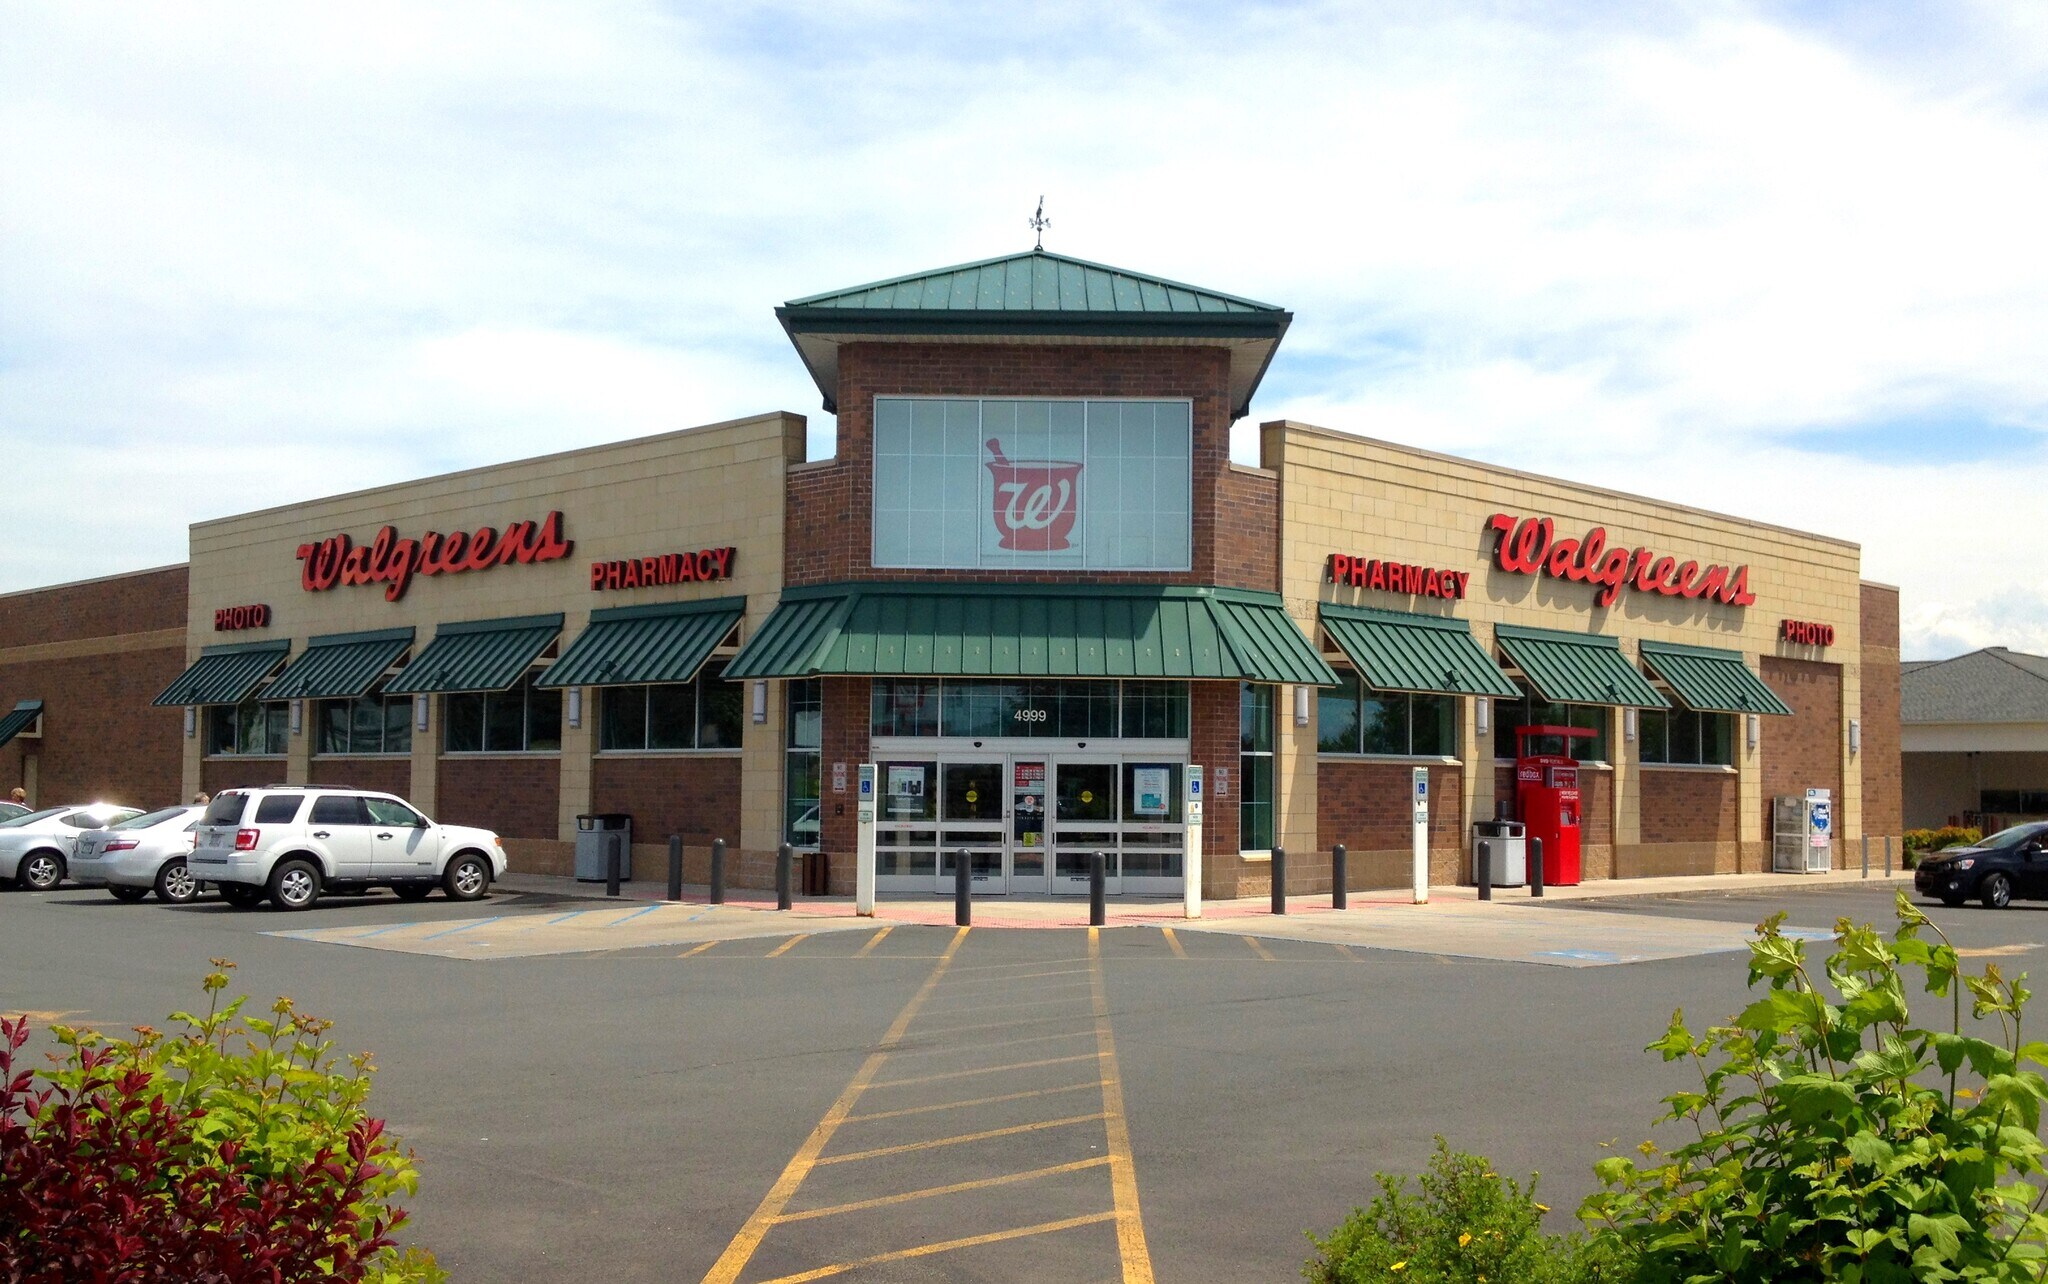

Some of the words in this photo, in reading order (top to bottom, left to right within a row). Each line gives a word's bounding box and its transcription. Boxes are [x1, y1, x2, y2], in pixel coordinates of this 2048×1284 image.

[998, 478, 1071, 530] W
[297, 510, 573, 602] Walgreens
[590, 547, 735, 591] PHARMACY
[1328, 553, 1470, 600] PHARMACY
[1488, 513, 1756, 607] Walgreens
[215, 604, 270, 630] PHOTO
[1783, 619, 1835, 646] PHOTO
[1013, 709, 1047, 722] 4999
[1519, 769, 1540, 779] redbox
